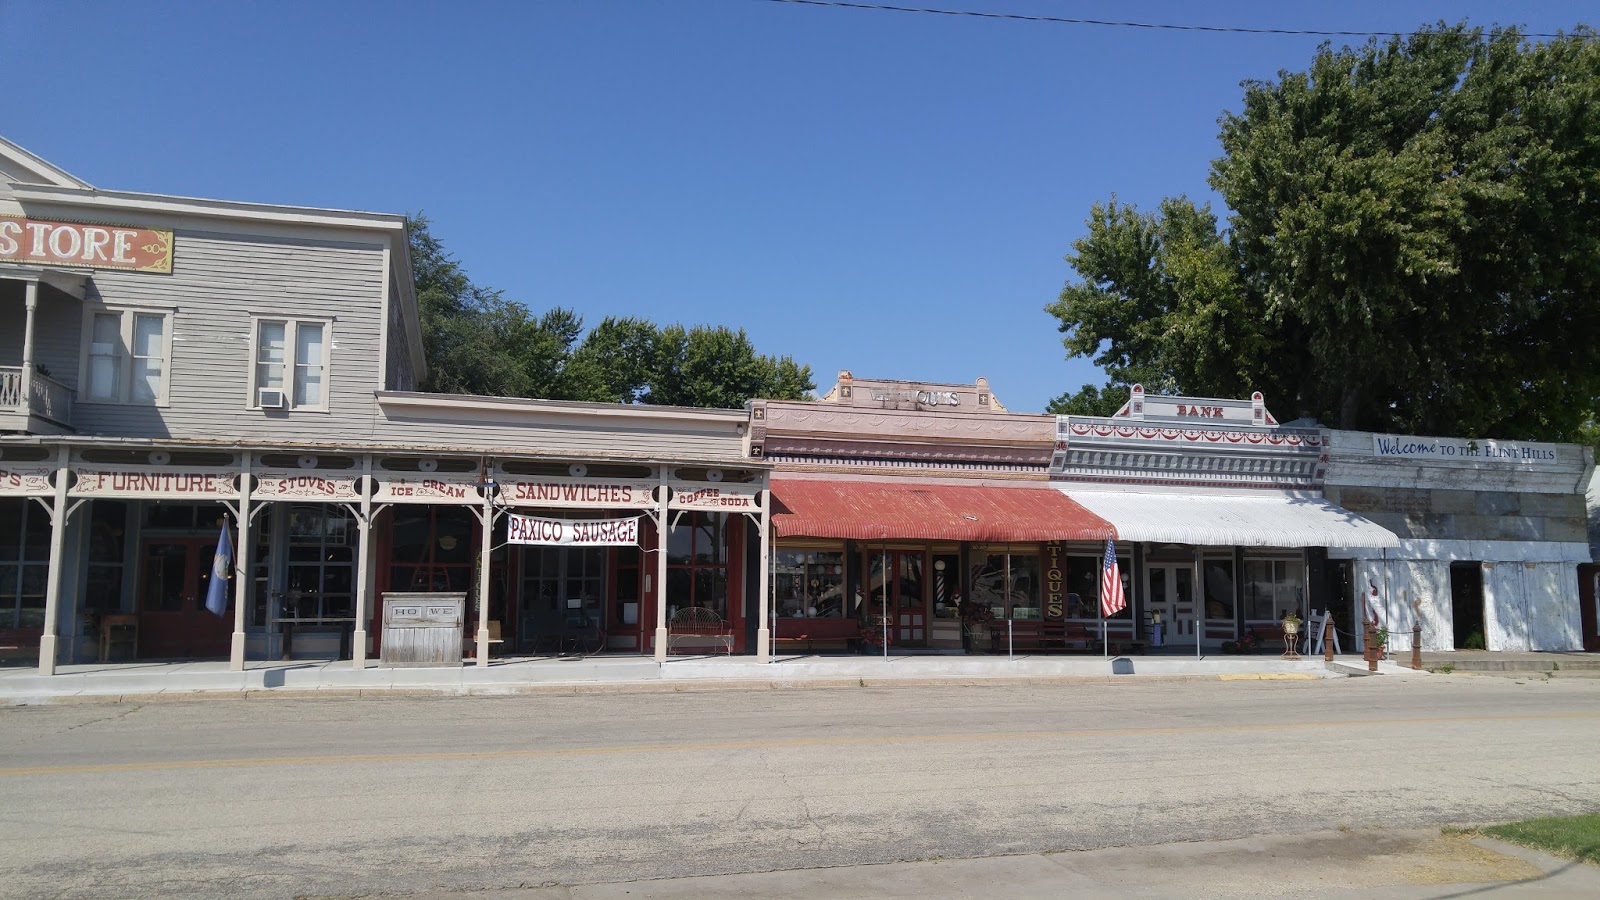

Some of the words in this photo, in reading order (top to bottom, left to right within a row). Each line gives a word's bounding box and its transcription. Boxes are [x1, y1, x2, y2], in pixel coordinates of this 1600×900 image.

[0, 221, 138, 263] STORE
[1176, 404, 1224, 418] BANK
[1377, 437, 1437, 455] Welcome
[1439, 445, 1455, 456] TO
[1458, 446, 1481, 457] THE
[1484, 445, 1519, 459] FLINT
[1521, 447, 1555, 460] HILLS
[97, 471, 217, 492] FURNITURE
[278, 476, 335, 495] STOVES
[391, 487, 413, 496] ICE
[422, 479, 466, 498] CREAM
[515, 482, 632, 502] SANDWICHES
[679, 488, 720, 504] COFFEE
[720, 497, 749, 507] SODA
[510, 517, 563, 542] PAXICO
[572, 520, 636, 542] SAUSAGE
